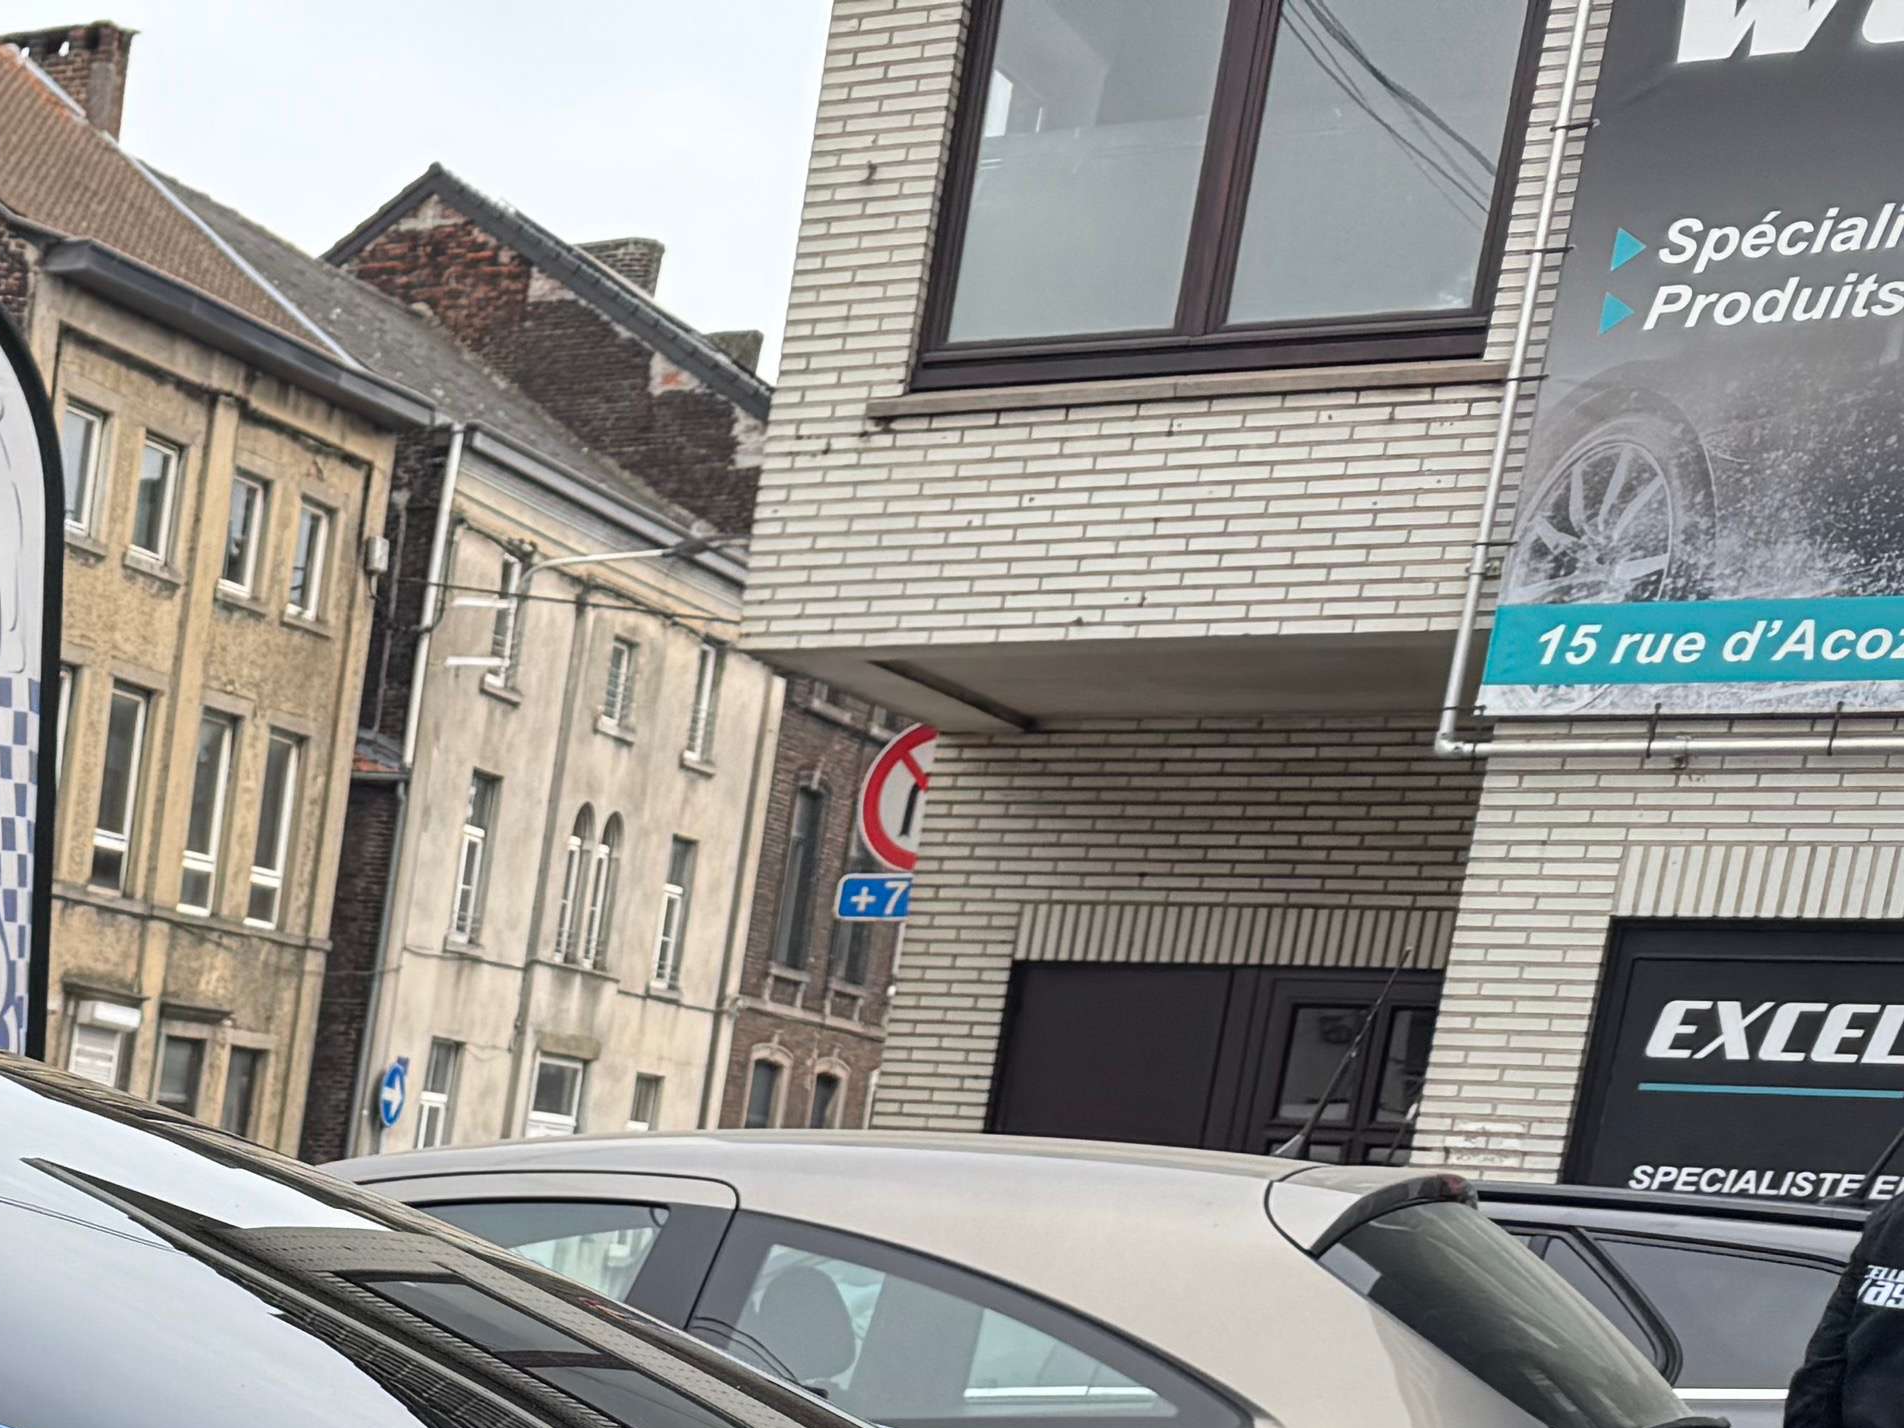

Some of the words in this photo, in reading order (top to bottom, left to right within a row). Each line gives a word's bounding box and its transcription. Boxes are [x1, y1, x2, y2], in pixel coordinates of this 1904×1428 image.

[1643, 272, 1904, 331] Produits
[1536, 623, 1602, 665] 15
[1609, 629, 1706, 664] rue
[1645, 999, 1904, 1064] EXCEL
[1628, 1164, 1865, 1198] SPECIALISTE
[1868, 1174, 1904, 1201] E
